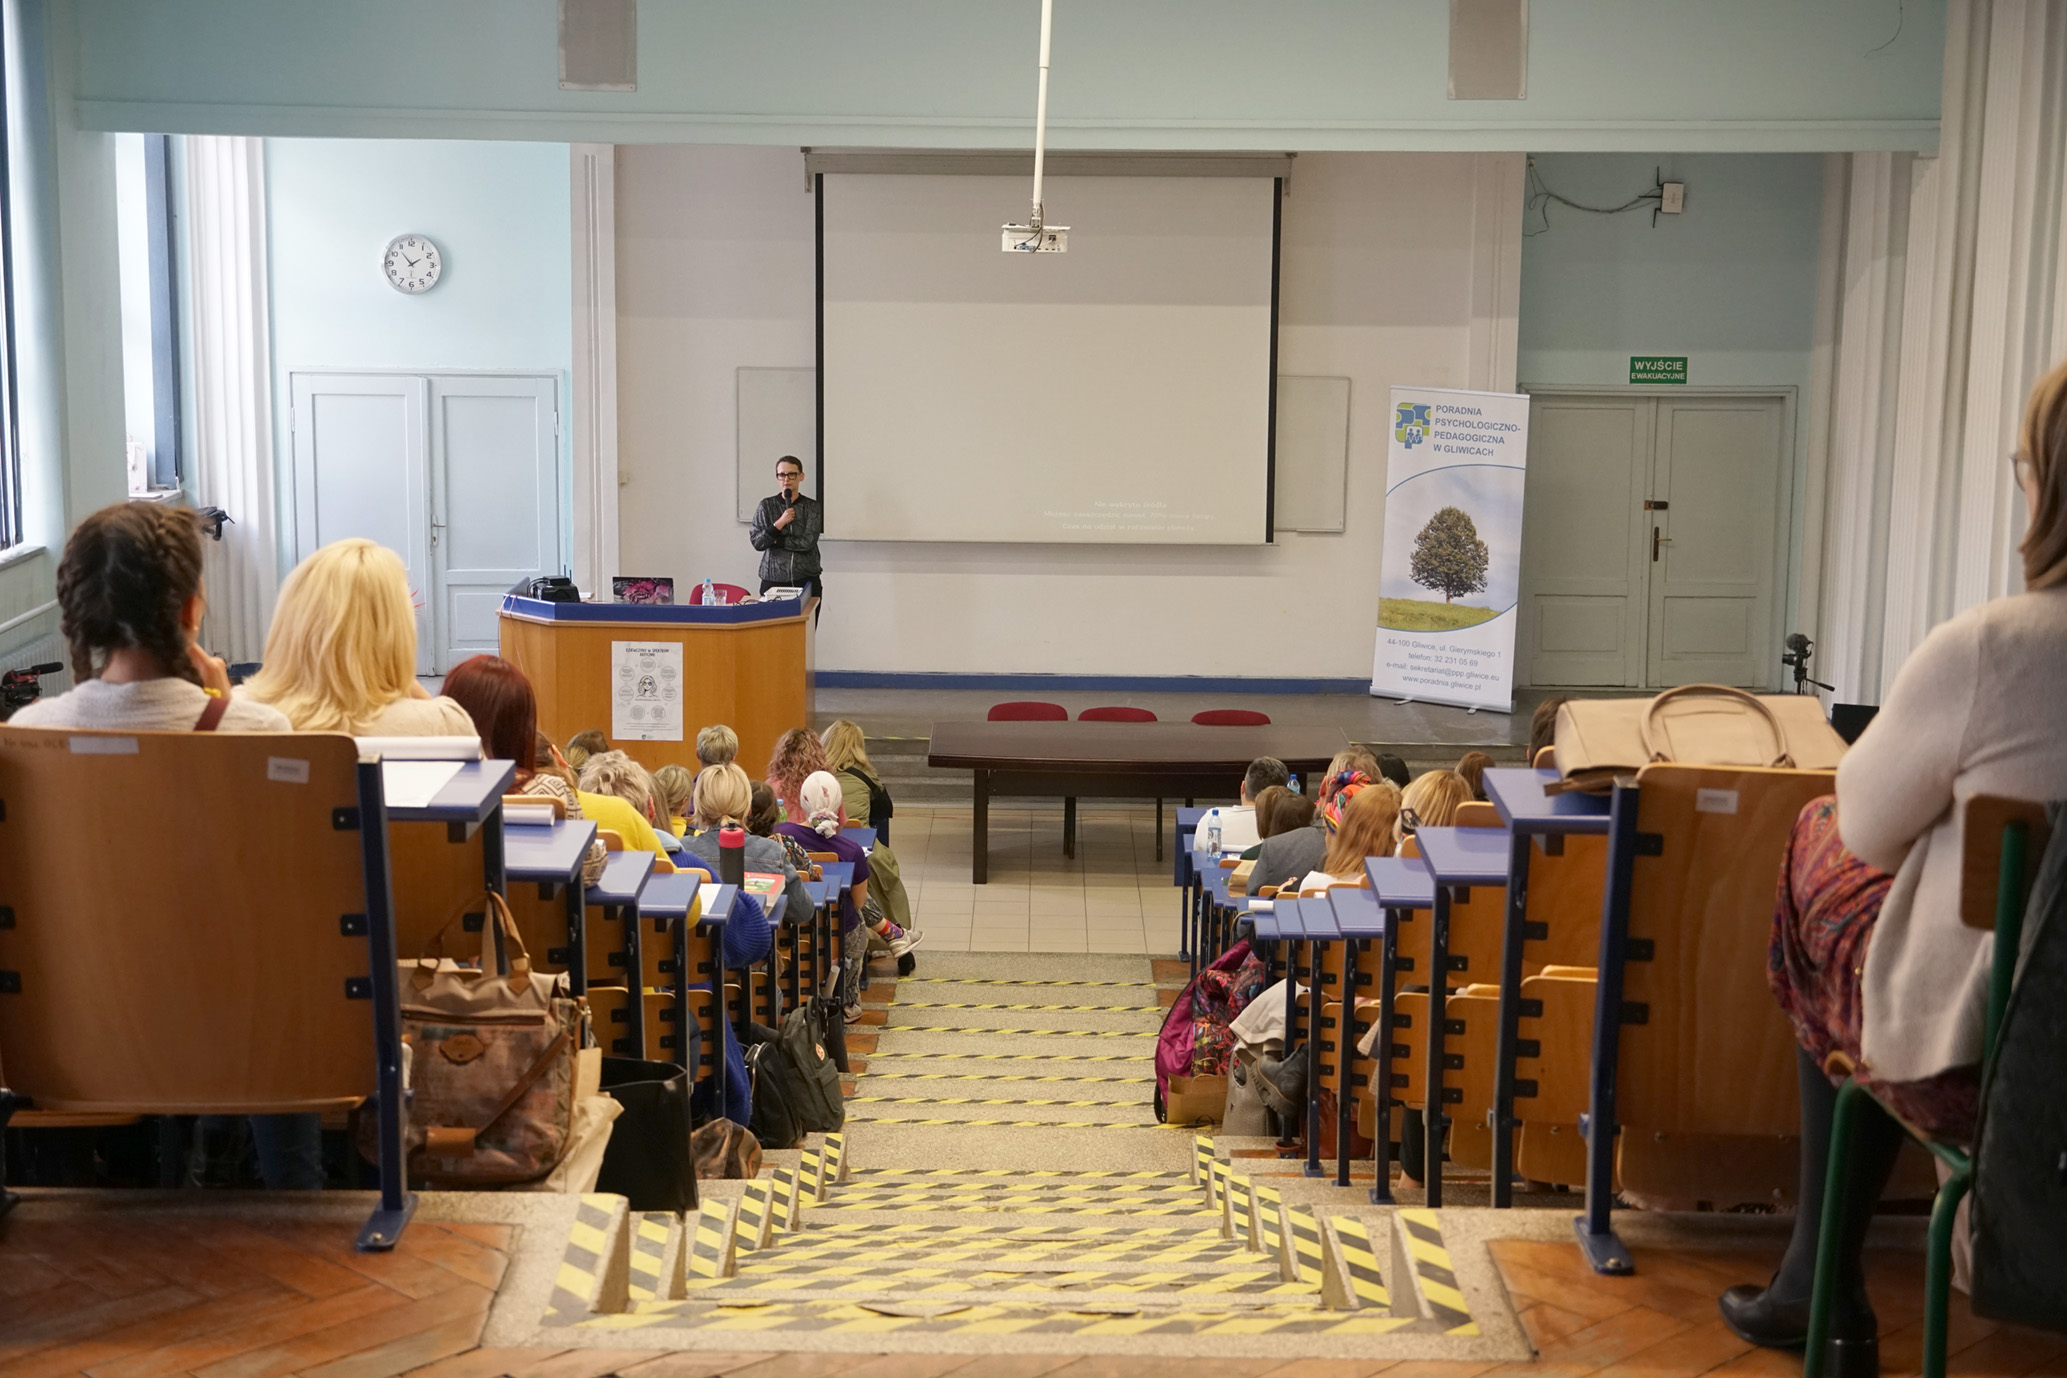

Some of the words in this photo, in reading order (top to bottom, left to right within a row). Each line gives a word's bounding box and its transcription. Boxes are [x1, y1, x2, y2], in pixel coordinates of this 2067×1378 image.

[1634, 360, 1683, 370] WYJŚCIE
[1631, 372, 1685, 380] EWAKUACYJNE
[1435, 405, 1482, 416] PORADNIA
[1434, 418, 1521, 432] PSYCHOLOGICZNO-
[1434, 431, 1505, 444] PEDAGOGICZNA
[1433, 444, 1441, 452] W
[1444, 445, 1494, 456] GLIWICACH
[1386, 638, 1411, 647] 44-100
[1411, 641, 1437, 651] Gliwice,
[1449, 645, 1496, 658] Gierymskiego
[1408, 652, 1432, 661] telefon:
[1444, 656, 1457, 664] 231
[1469, 659, 1478, 667] 69
[1386, 662, 1408, 670] e-mail:
